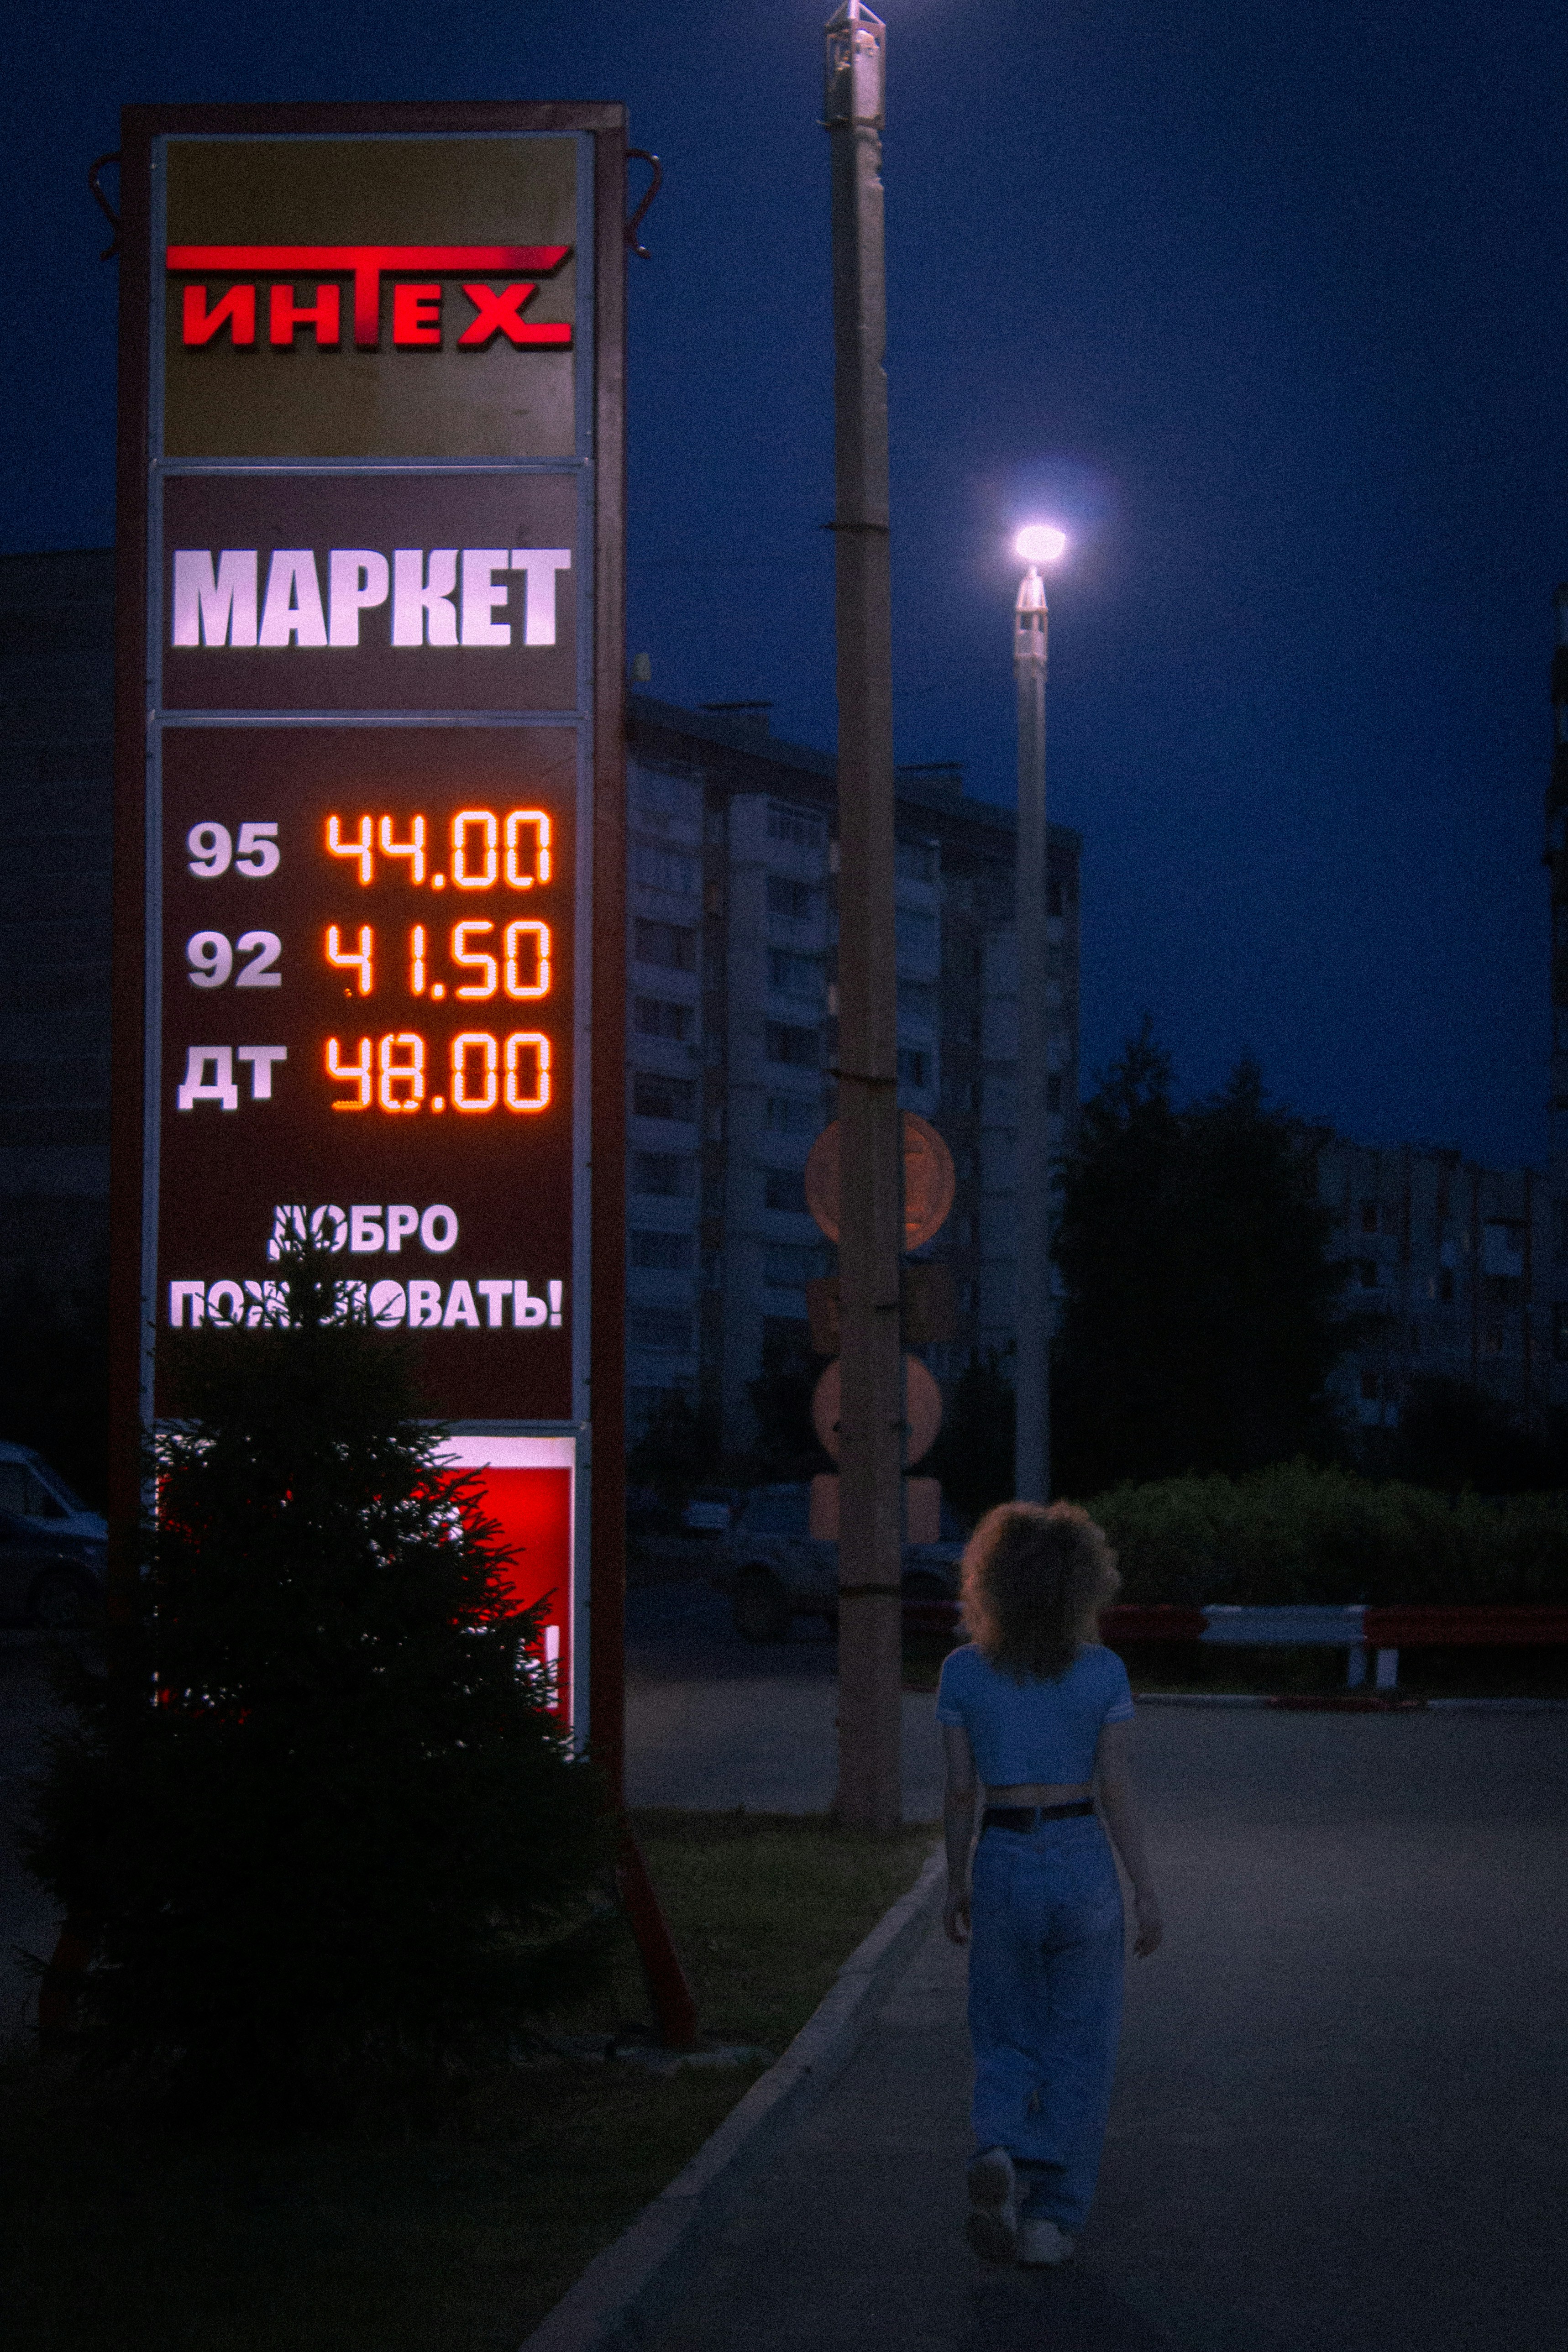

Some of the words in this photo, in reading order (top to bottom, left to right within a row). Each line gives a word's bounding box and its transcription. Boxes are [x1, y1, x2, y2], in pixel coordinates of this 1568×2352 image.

[167, 246, 571, 345] ИНТЕХ
[172, 548, 571, 647] МАРКЕТ
[187, 822, 281, 878] 95
[325, 808, 552, 890] 44.00
[187, 930, 282, 988] 92
[325, 919, 552, 1000] 41.50
[177, 1045, 288, 1112] ДТ
[325, 1031, 552, 1113] 48.00
[267, 1204, 459, 1262] ДОБРО
[169, 1279, 563, 1329] ПОЖЛОВАТЬ!
